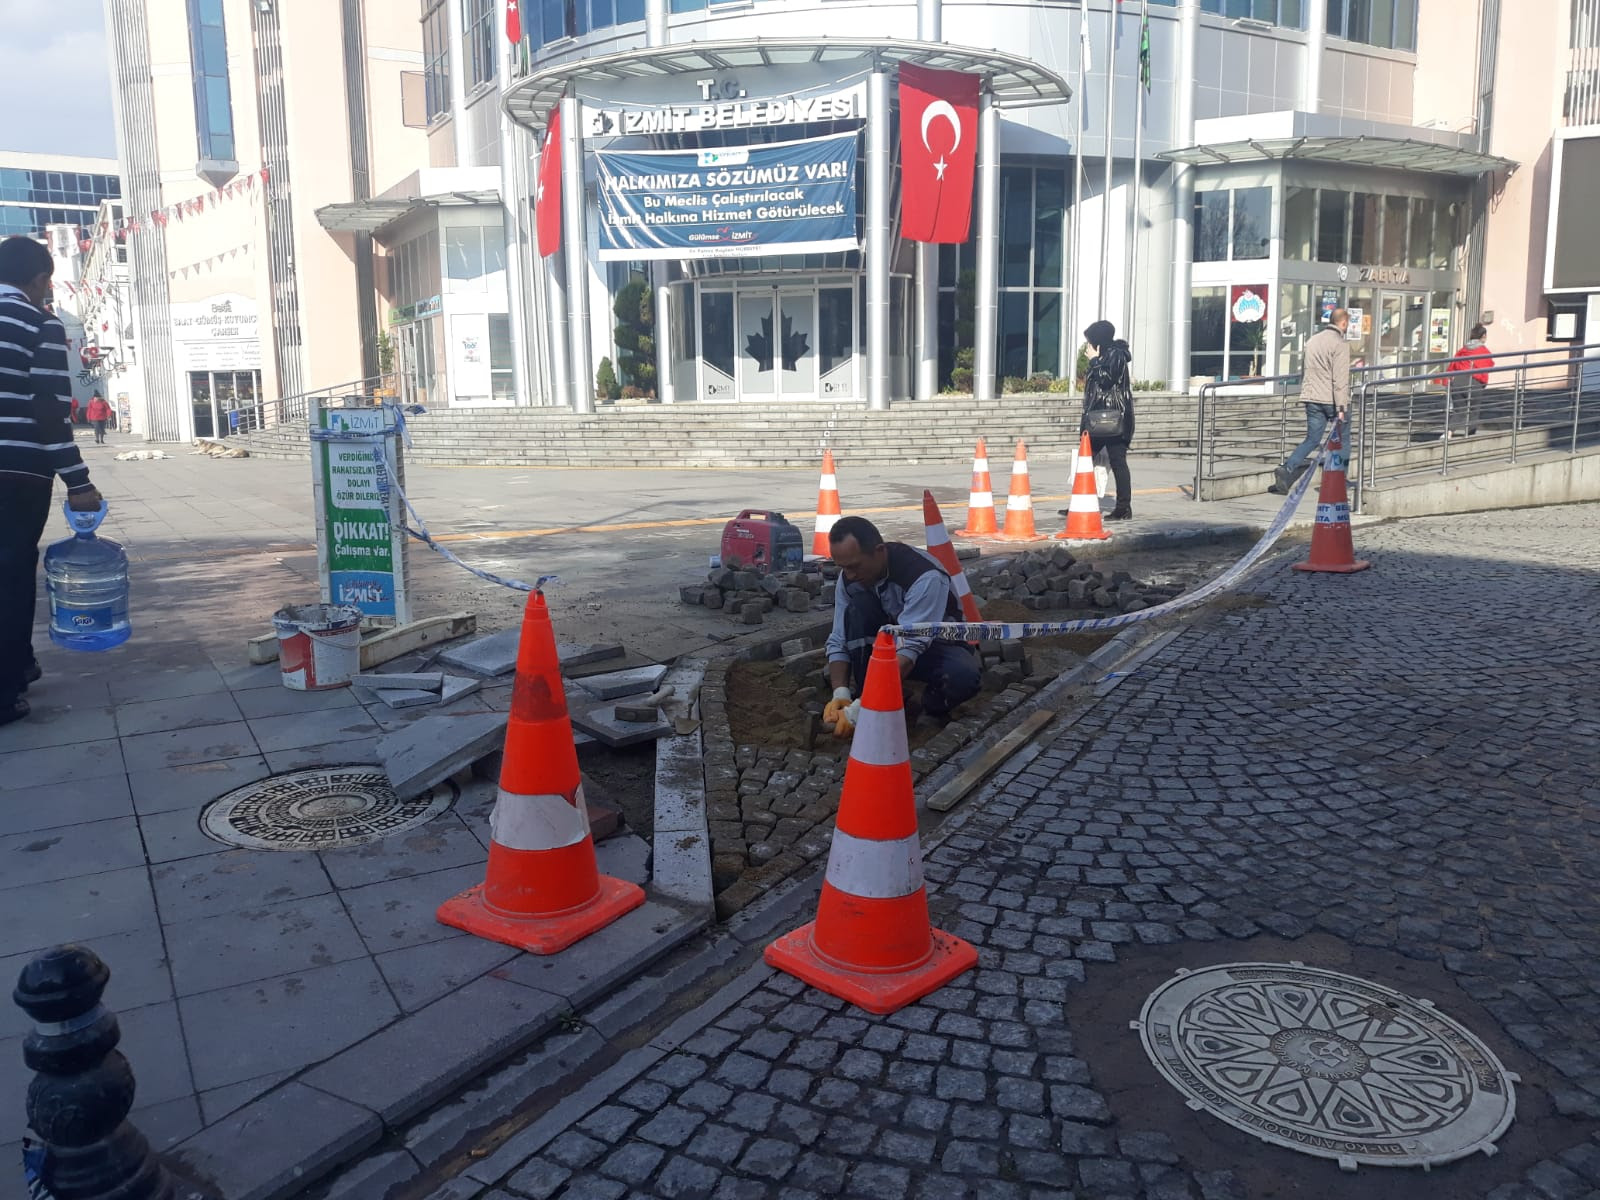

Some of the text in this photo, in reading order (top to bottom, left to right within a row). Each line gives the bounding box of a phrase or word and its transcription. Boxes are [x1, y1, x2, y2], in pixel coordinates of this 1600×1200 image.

[699, 92, 860, 129] BELEDİYESİ
[605, 160, 847, 190] HALKIMIZA SÖZÜMÜZ VAR!
[643, 187, 804, 208] Bu Meclis Çalıştırılacak
[645, 211, 698, 224] Halkına
[702, 208, 752, 221] Hizmet
[756, 201, 845, 219] Götürülecek
[347, 479, 370, 488] DOLAYI
[335, 543, 371, 559] Çalışma
[1239, 1112, 1337, 1149] ANADOLU
